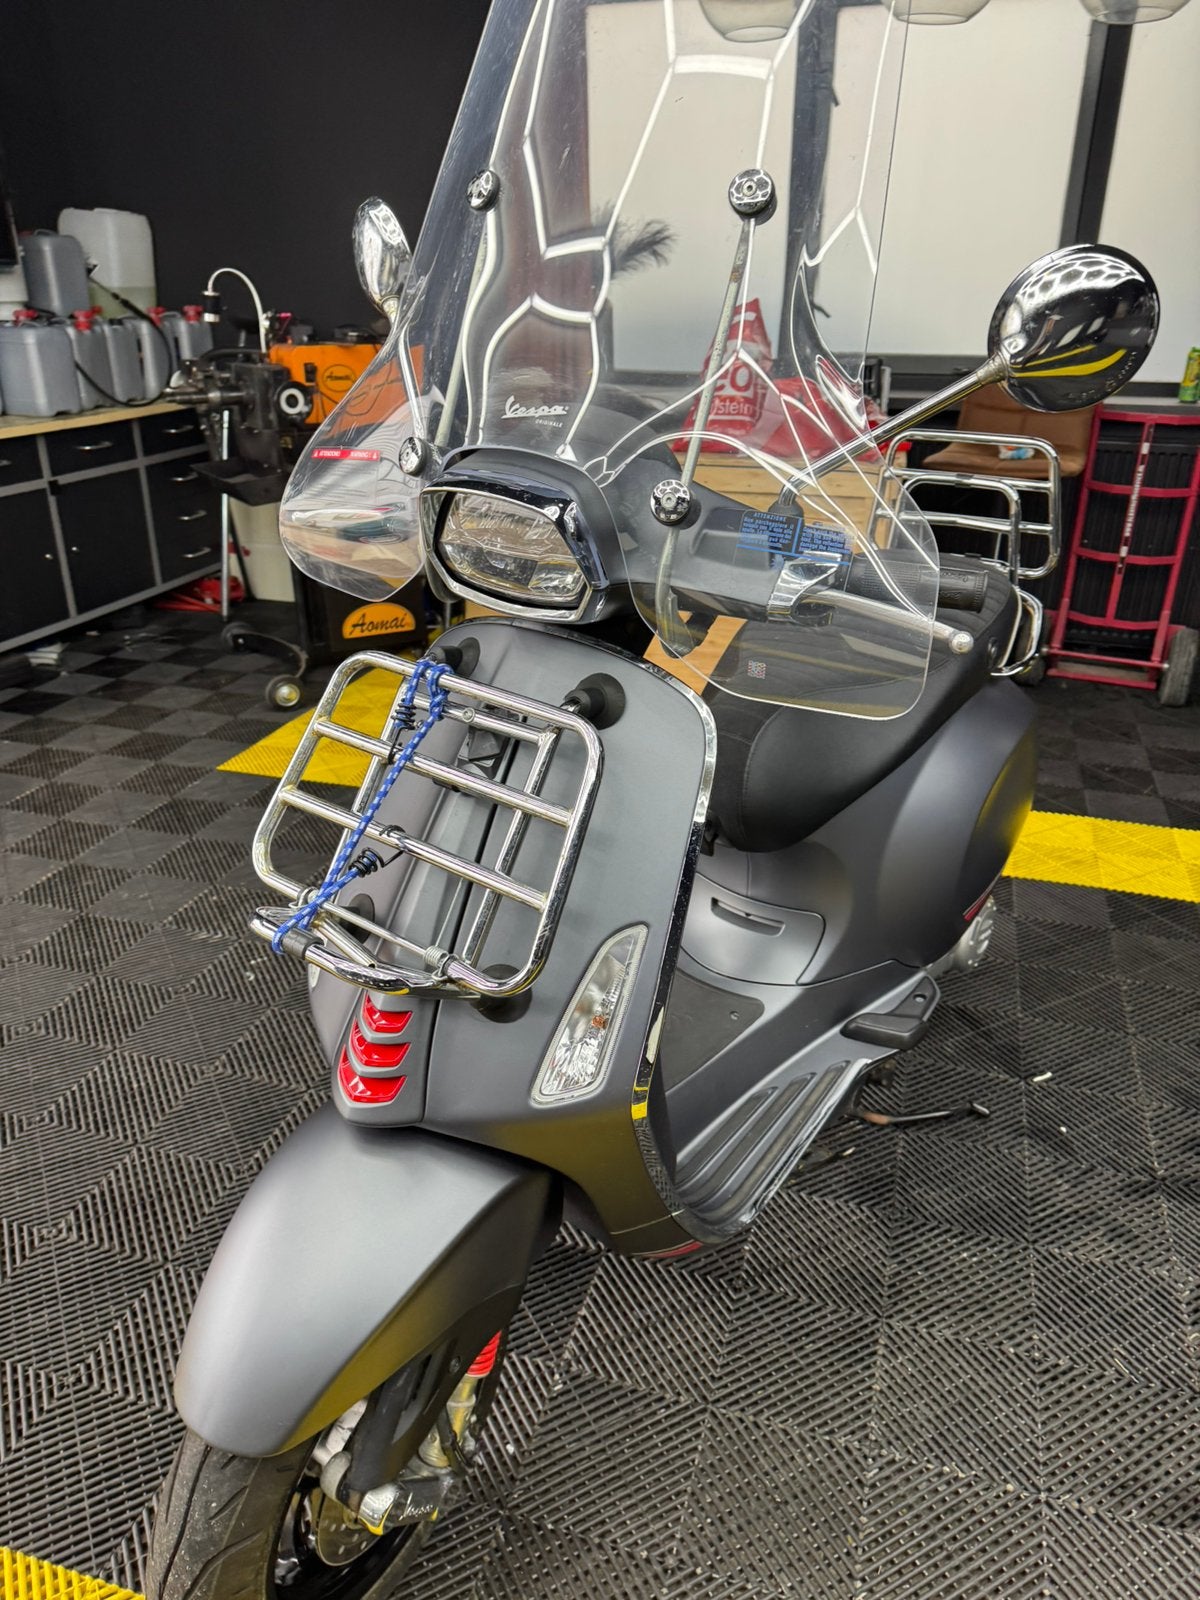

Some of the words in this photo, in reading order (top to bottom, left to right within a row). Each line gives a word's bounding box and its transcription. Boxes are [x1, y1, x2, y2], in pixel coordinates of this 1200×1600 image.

[501, 395, 568, 419] Vespa
[535, 419, 563, 428] ORIGINALE
[349, 612, 407, 636] Aomai
